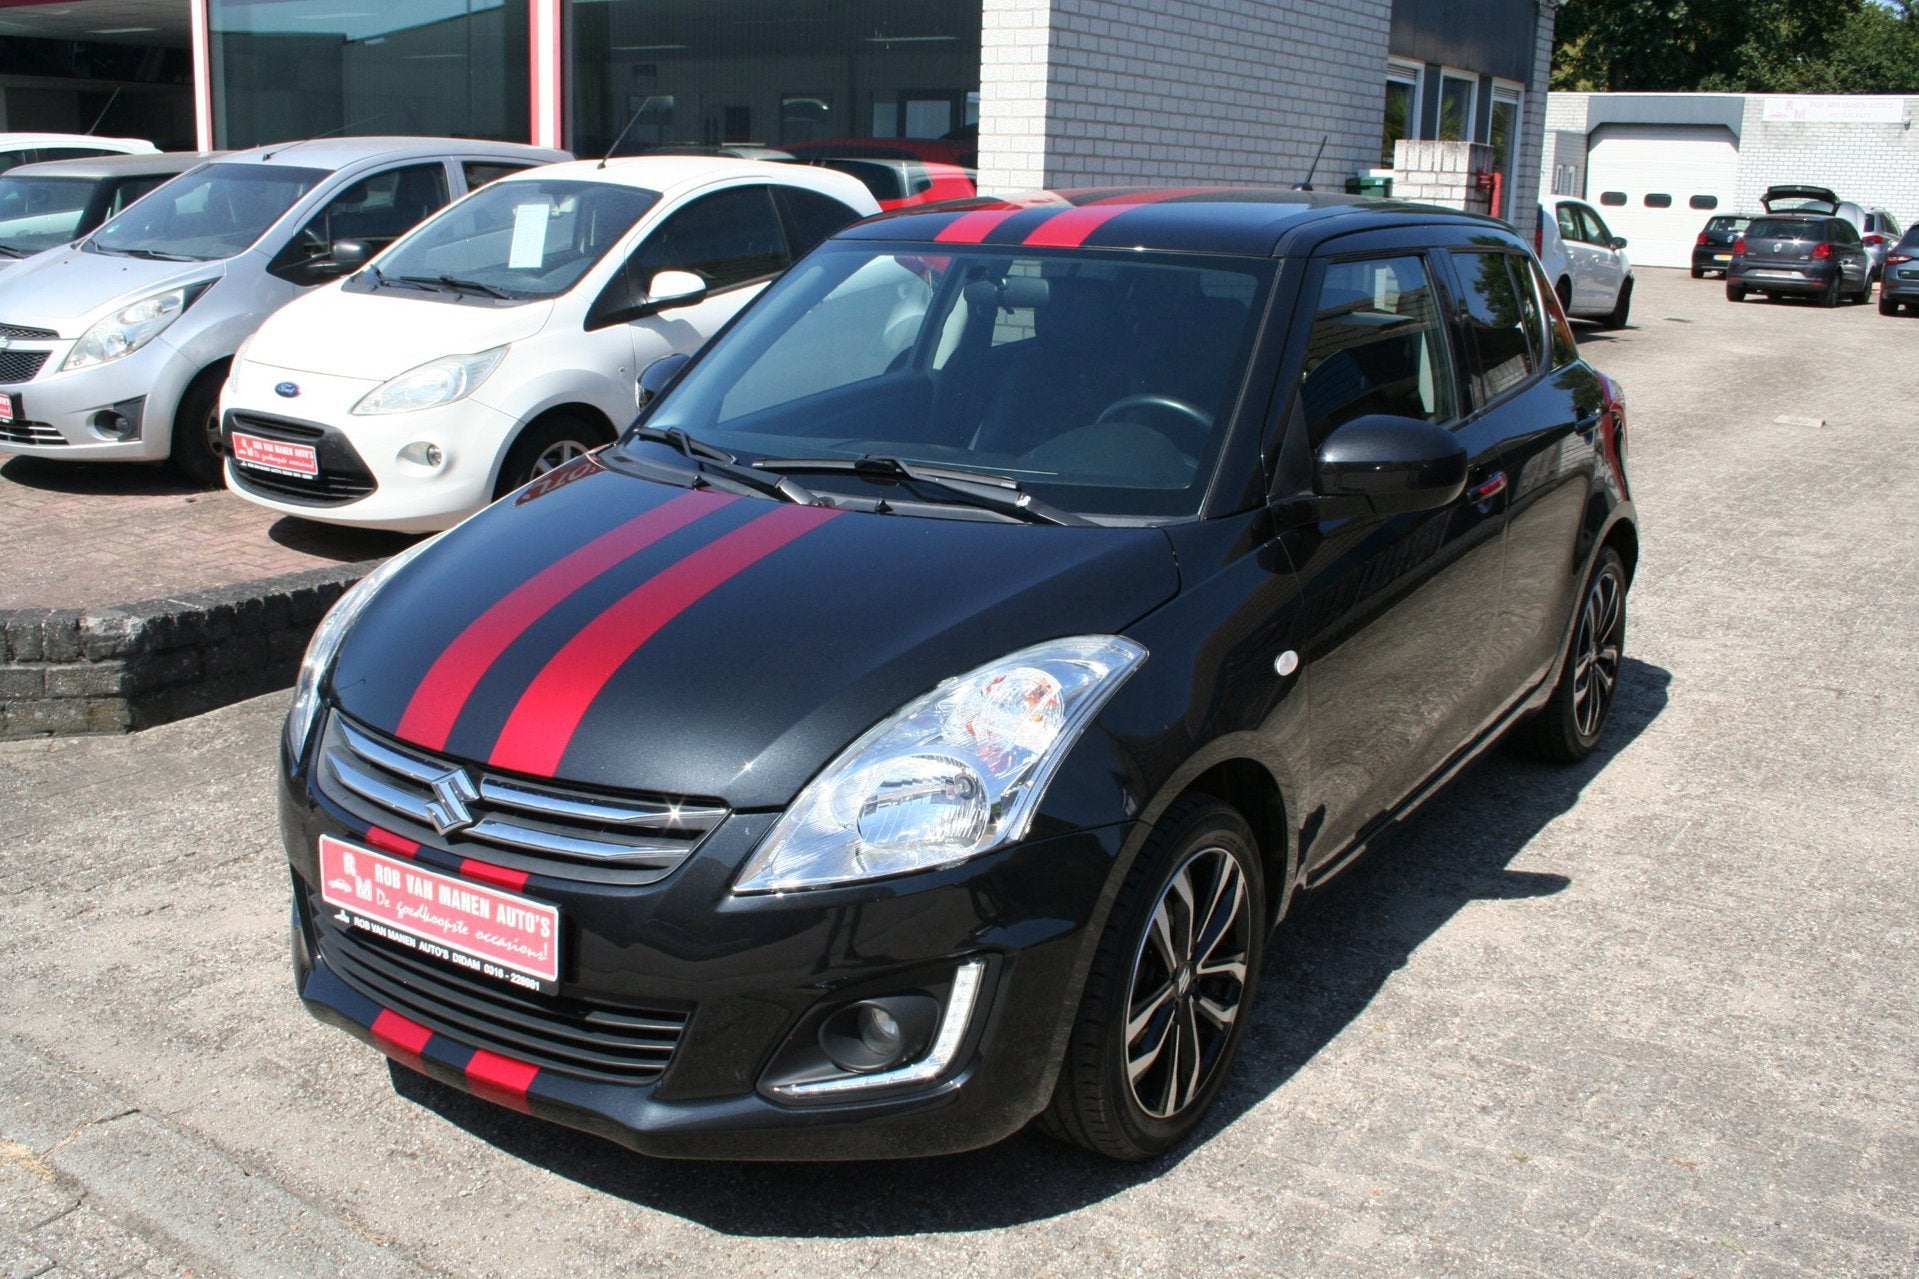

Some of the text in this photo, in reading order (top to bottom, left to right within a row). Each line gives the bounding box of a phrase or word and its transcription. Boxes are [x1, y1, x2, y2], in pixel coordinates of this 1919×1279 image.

[1785, 100, 1793, 111] R
[1794, 109, 1806, 120] M
[278, 384, 295, 393] Ford
[343, 852, 356, 877] R
[355, 875, 373, 902] M
[375, 863, 551, 938] ROB VAN MANEN AUTO'S
[375, 888, 549, 962] De goedkoopste occasions!
[354, 917, 370, 930] ROB
[371, 923, 387, 936] VAN
[387, 929, 416, 947] MANEN
[418, 941, 449, 959] AUTO'S
[452, 952, 481, 971] DIDAM
[484, 963, 504, 979] 0316
